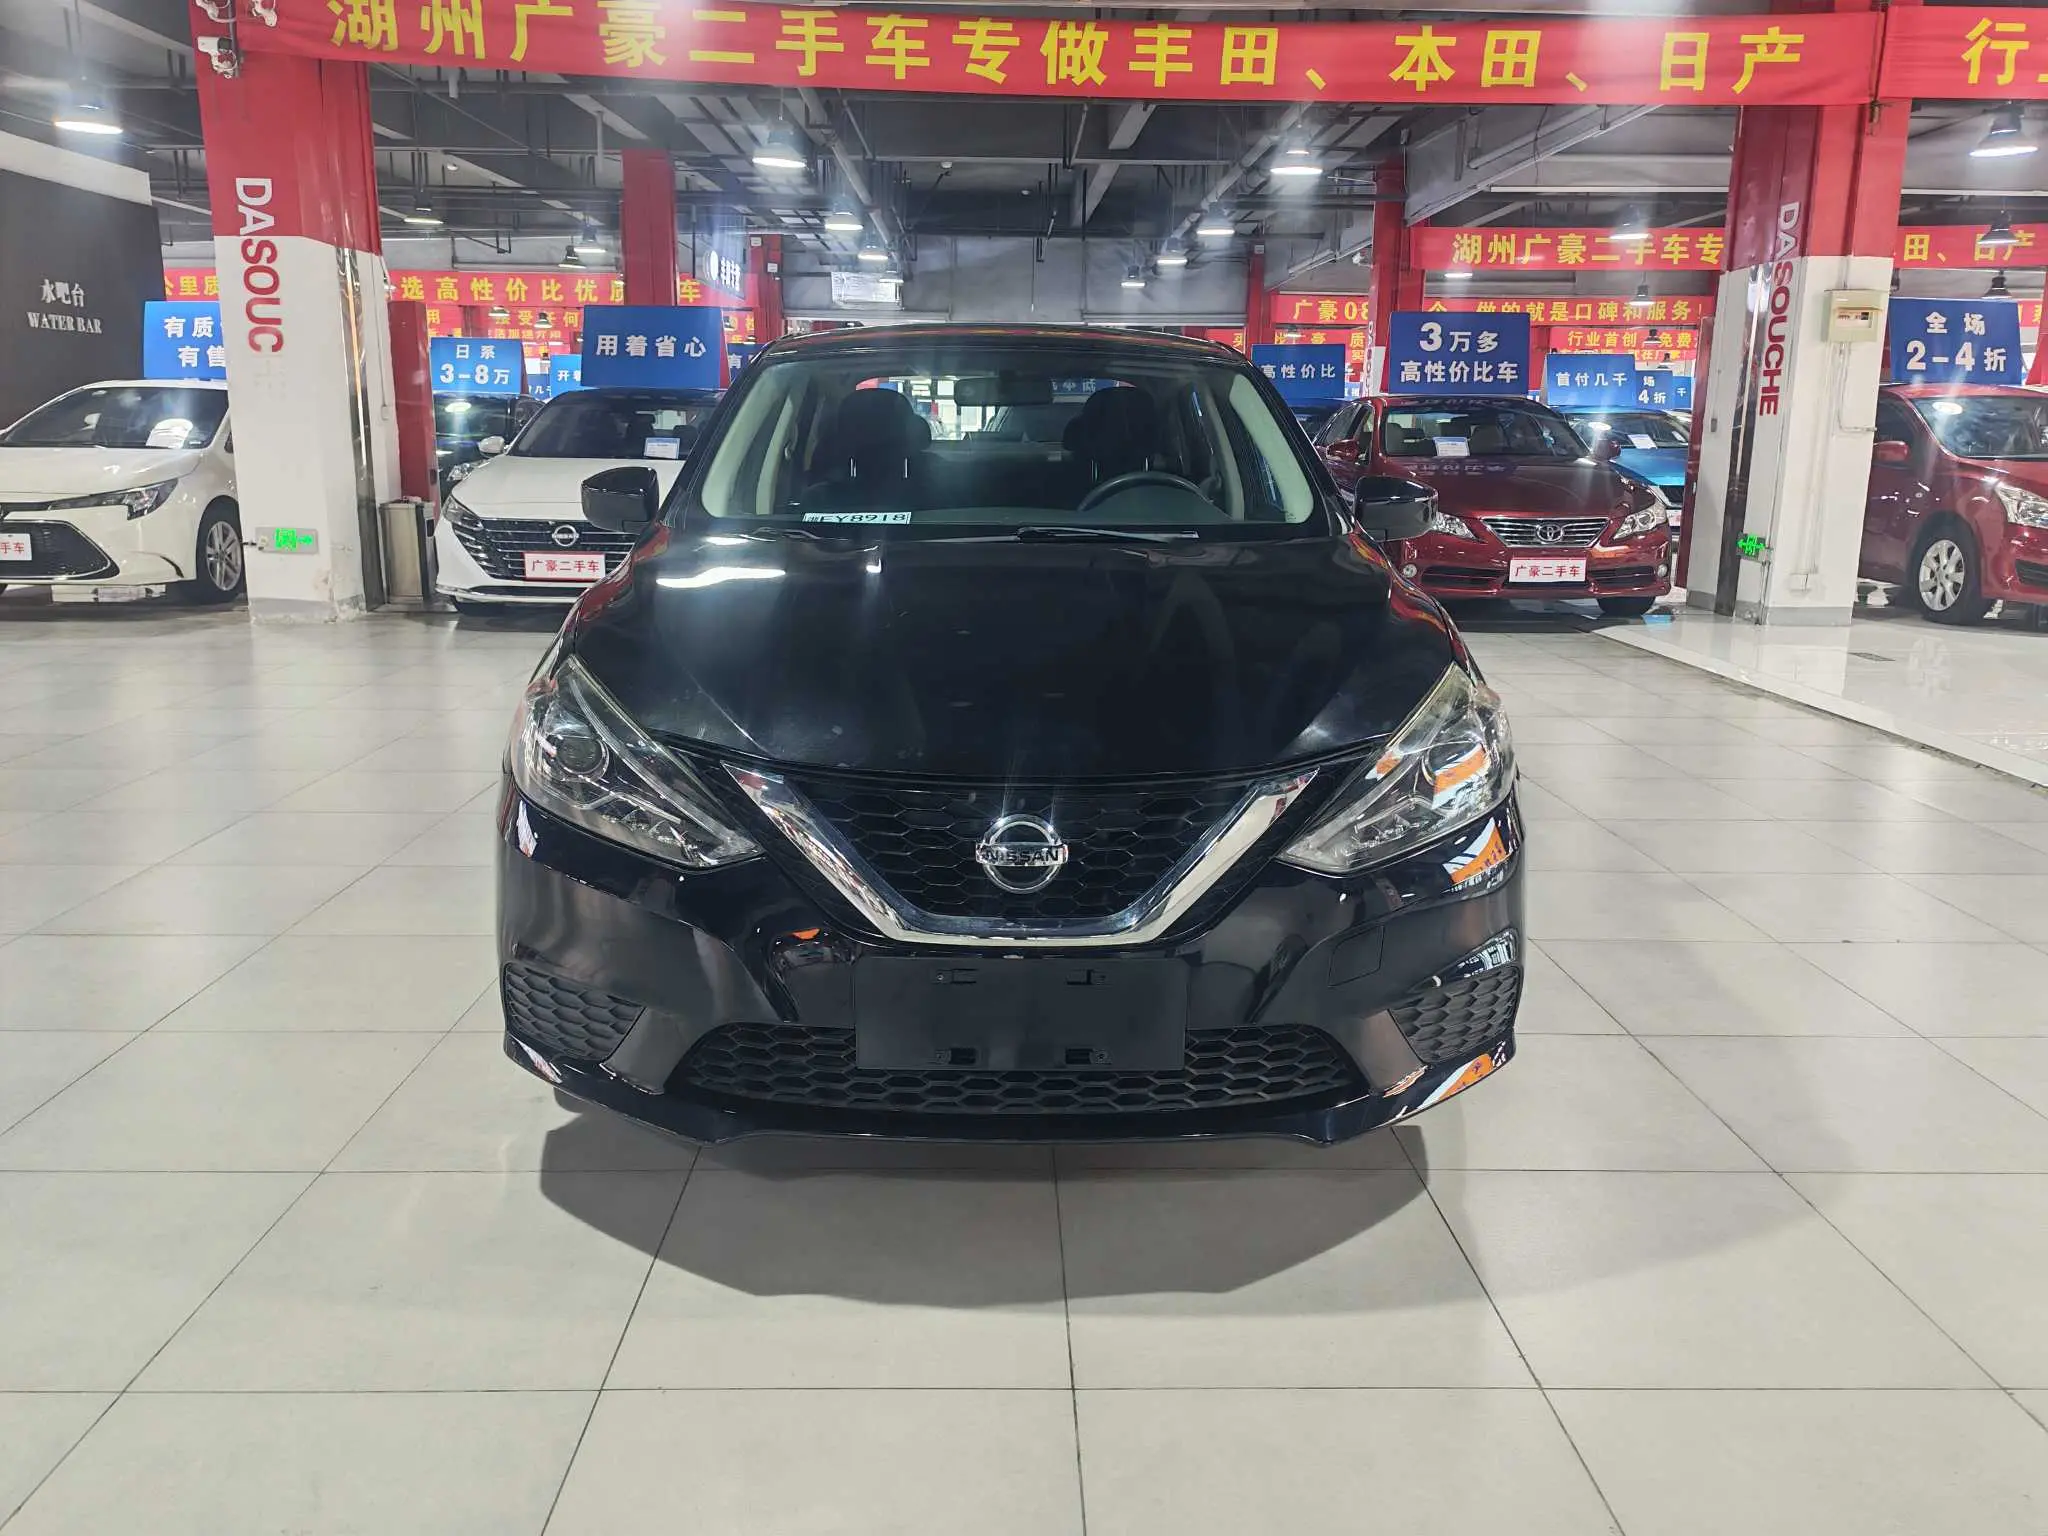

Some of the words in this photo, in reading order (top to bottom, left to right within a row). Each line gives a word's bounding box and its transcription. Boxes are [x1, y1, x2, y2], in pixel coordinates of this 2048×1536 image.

[1961, 17, 2048, 86] 行
[41, 279, 84, 307] 水吧台
[1759, 201, 1800, 417] DASOUCHE
[27, 312, 75, 331] WATER
[76, 317, 102, 334] BAR
[1925, 312, 1986, 336] 全场
[596, 334, 707, 358] 用着省心
[1420, 321, 1499, 353] 3万多
[456, 344, 495, 359] 日系
[1907, 340, 2007, 373] 2-4折
[440, 363, 511, 385] 3-8万
[1400, 360, 1519, 383] 高性价比车
[1556, 372, 1628, 387] 首付几千
[531, 559, 600, 572] 广豪二手车
[1515, 565, 1580, 577] 广豪二手车
[985, 848, 1059, 862] NISSAN
